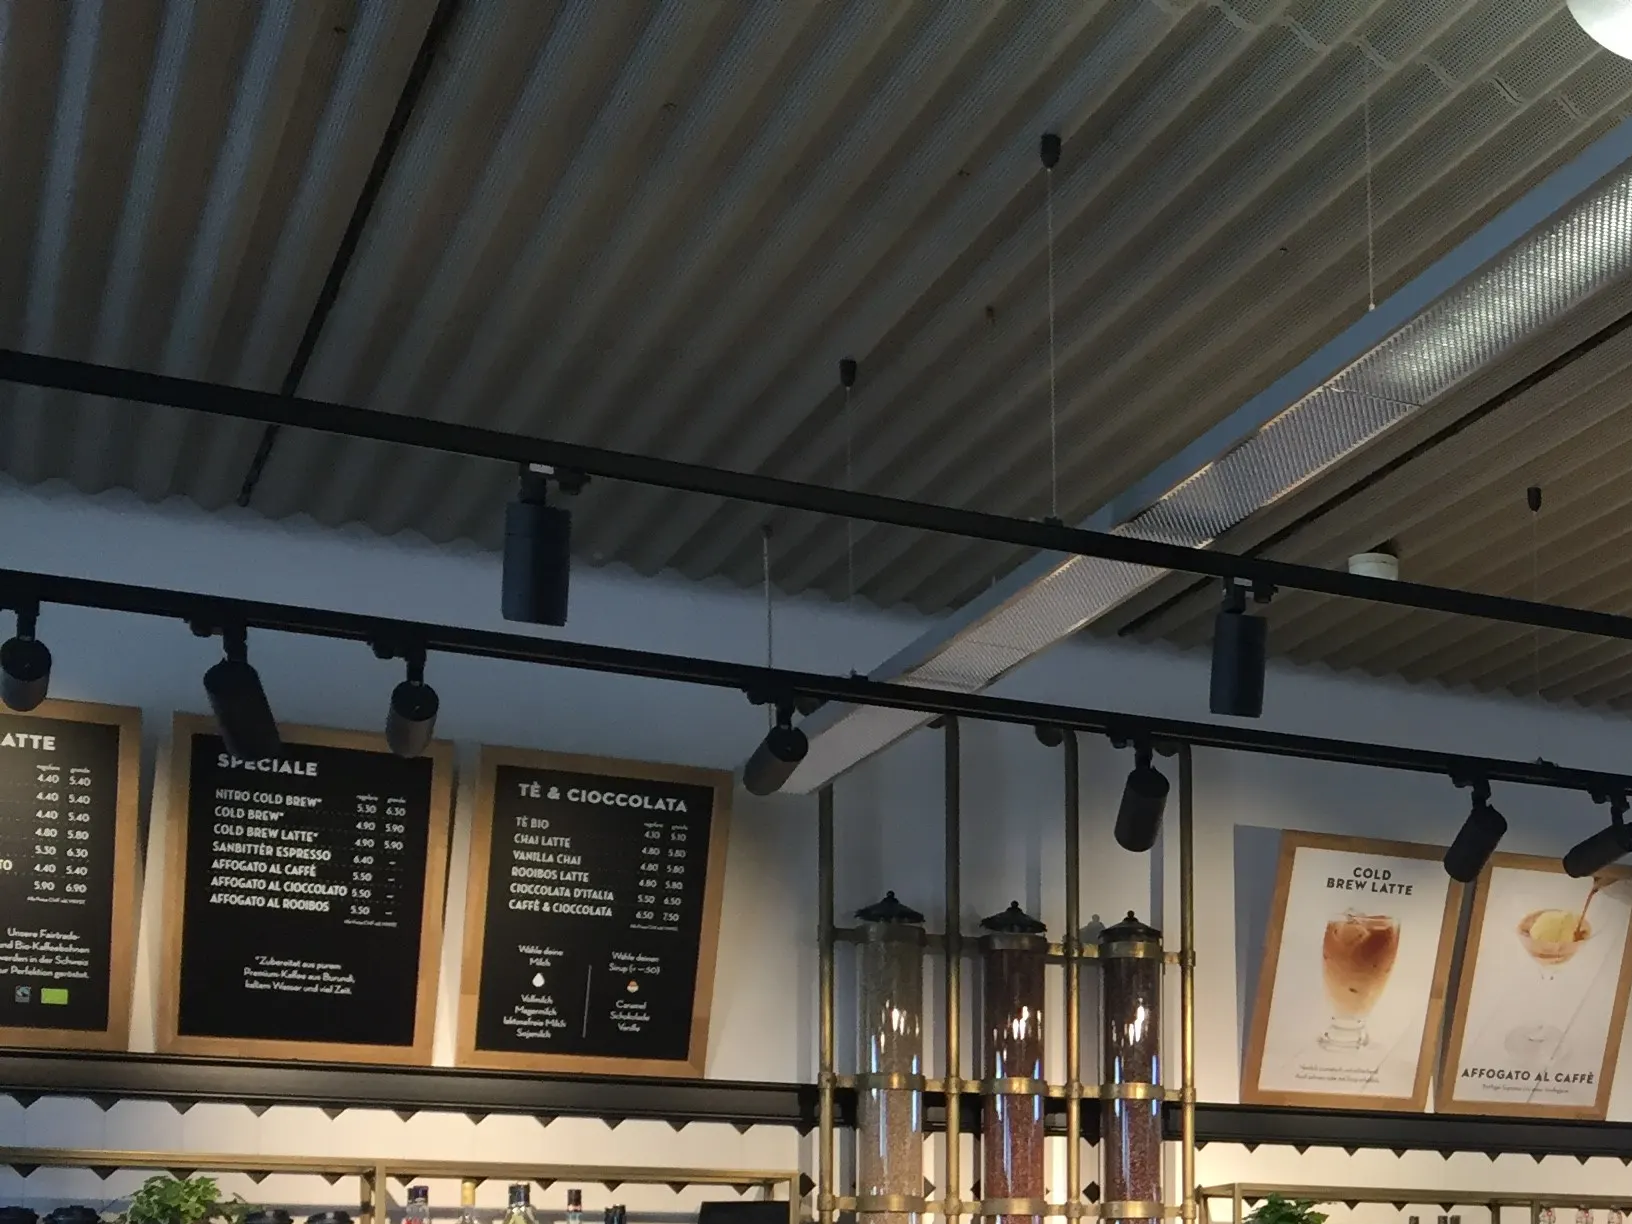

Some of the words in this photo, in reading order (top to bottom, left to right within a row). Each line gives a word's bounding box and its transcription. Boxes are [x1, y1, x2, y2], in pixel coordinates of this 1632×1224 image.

[217, 753, 318, 776] SPECIALE
[37, 774, 60, 783] 4.40
[69, 776, 91, 786] 5.40
[36, 792, 59, 801] 4.40
[68, 794, 90, 804] 5.40
[215, 788, 250, 801] NITRO
[253, 792, 283, 804] COLD
[547, 786, 560, 800] &
[567, 788, 687, 812] CIOCCOLATA
[36, 810, 58, 819] 4.40
[68, 812, 90, 822] 5.40
[215, 806, 245, 818] COLD
[213, 823, 244, 836] COLD
[246, 827, 279, 838] BREW
[531, 818, 549, 829] BIO
[35, 828, 58, 837] 4.80
[67, 830, 89, 840] 5.80
[541, 837, 571, 848] LATTE
[35, 845, 56, 855] 5.30
[66, 848, 88, 858] 6.30
[276, 846, 331, 861] ESPRESSO
[513, 850, 554, 863] VANILLA
[34, 863, 56, 873] 4.40
[66, 866, 88, 876] 5.40
[211, 859, 267, 873] AFFOGATO
[269, 864, 282, 874] AL
[512, 866, 557, 880] ROOIBOS
[560, 871, 589, 883] LATTE
[1353, 867, 1392, 881] COLD
[211, 876, 266, 890] AFFOGATO
[268, 881, 281, 891] AL
[283, 882, 348, 897] CIOCCOLATO
[510, 883, 571, 897] CIOCCOLATA
[1327, 877, 1367, 893] BREW
[1370, 882, 1414, 896] LATTE
[210, 893, 266, 907] AFFOGATO
[267, 898, 280, 908] AL
[282, 898, 330, 912] ROOIBOS
[552, 904, 612, 917] CIOCCOLATA
[1461, 1068, 1531, 1082] AFFOGATO
[1534, 1071, 1550, 1082] AL
[1554, 1071, 1594, 1084] CAFFÈ
